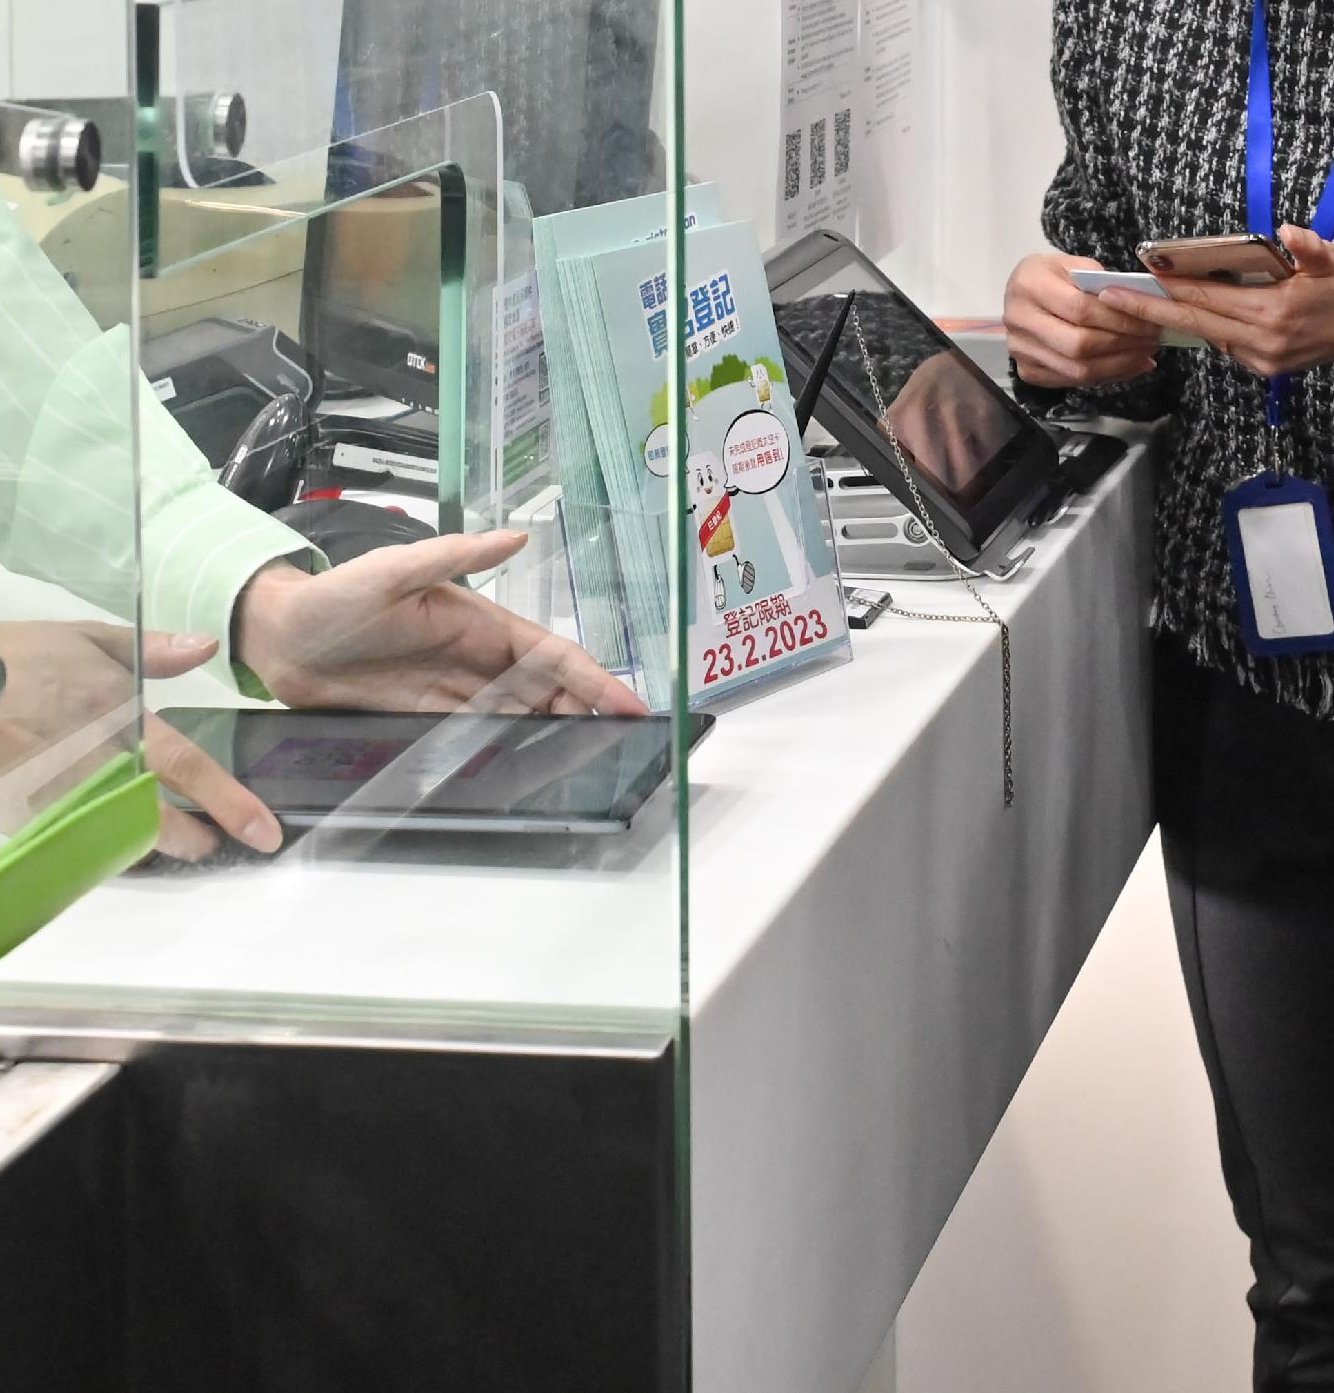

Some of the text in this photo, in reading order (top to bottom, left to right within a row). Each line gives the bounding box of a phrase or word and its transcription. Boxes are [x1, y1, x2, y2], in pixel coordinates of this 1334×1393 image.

[723, 593, 793, 639] 登記限期
[703, 609, 829, 686] 23.2.2023
